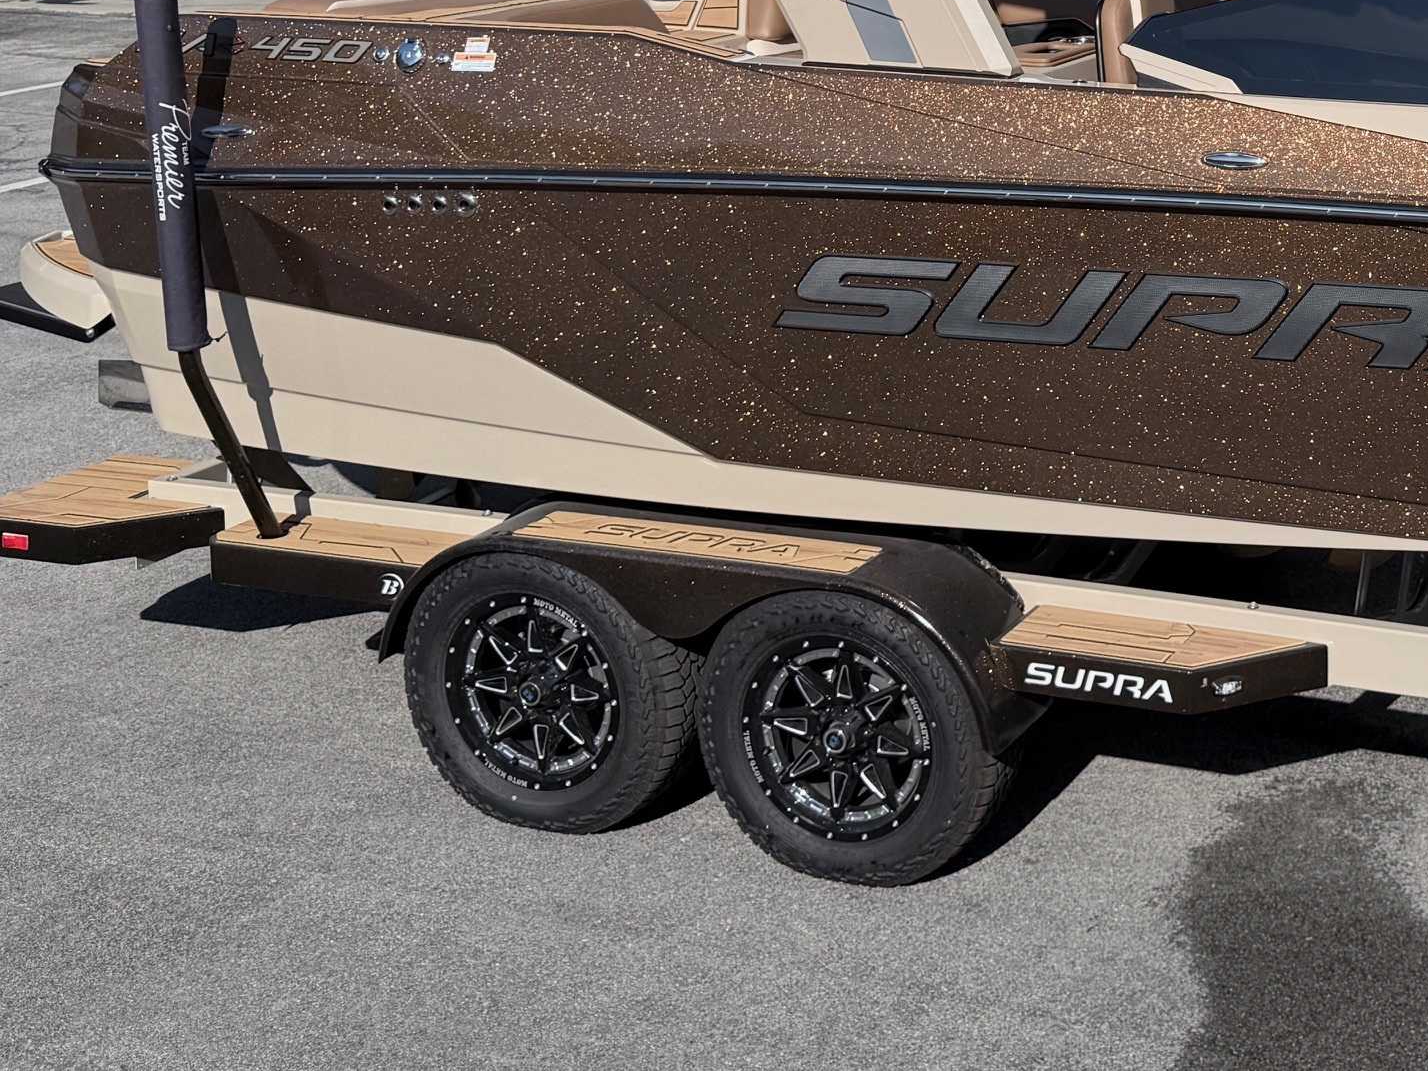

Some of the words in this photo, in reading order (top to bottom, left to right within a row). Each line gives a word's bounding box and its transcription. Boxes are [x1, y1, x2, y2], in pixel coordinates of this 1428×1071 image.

[251, 36, 373, 64] 450
[158, 98, 192, 210] Premier
[181, 140, 190, 166] TEAM
[151, 132, 166, 221] WATERSPORTS
[584, 523, 802, 558] SUPRA
[533, 597, 554, 611] MOTO
[554, 606, 578, 628] METAL
[1024, 662, 1173, 704] SUPRA
[909, 696, 923, 720] MOTO
[919, 721, 930, 751] METAL
[743, 730, 754, 759] METAL
[506, 775, 528, 788] MOTO
[750, 759, 765, 783] MOTO
